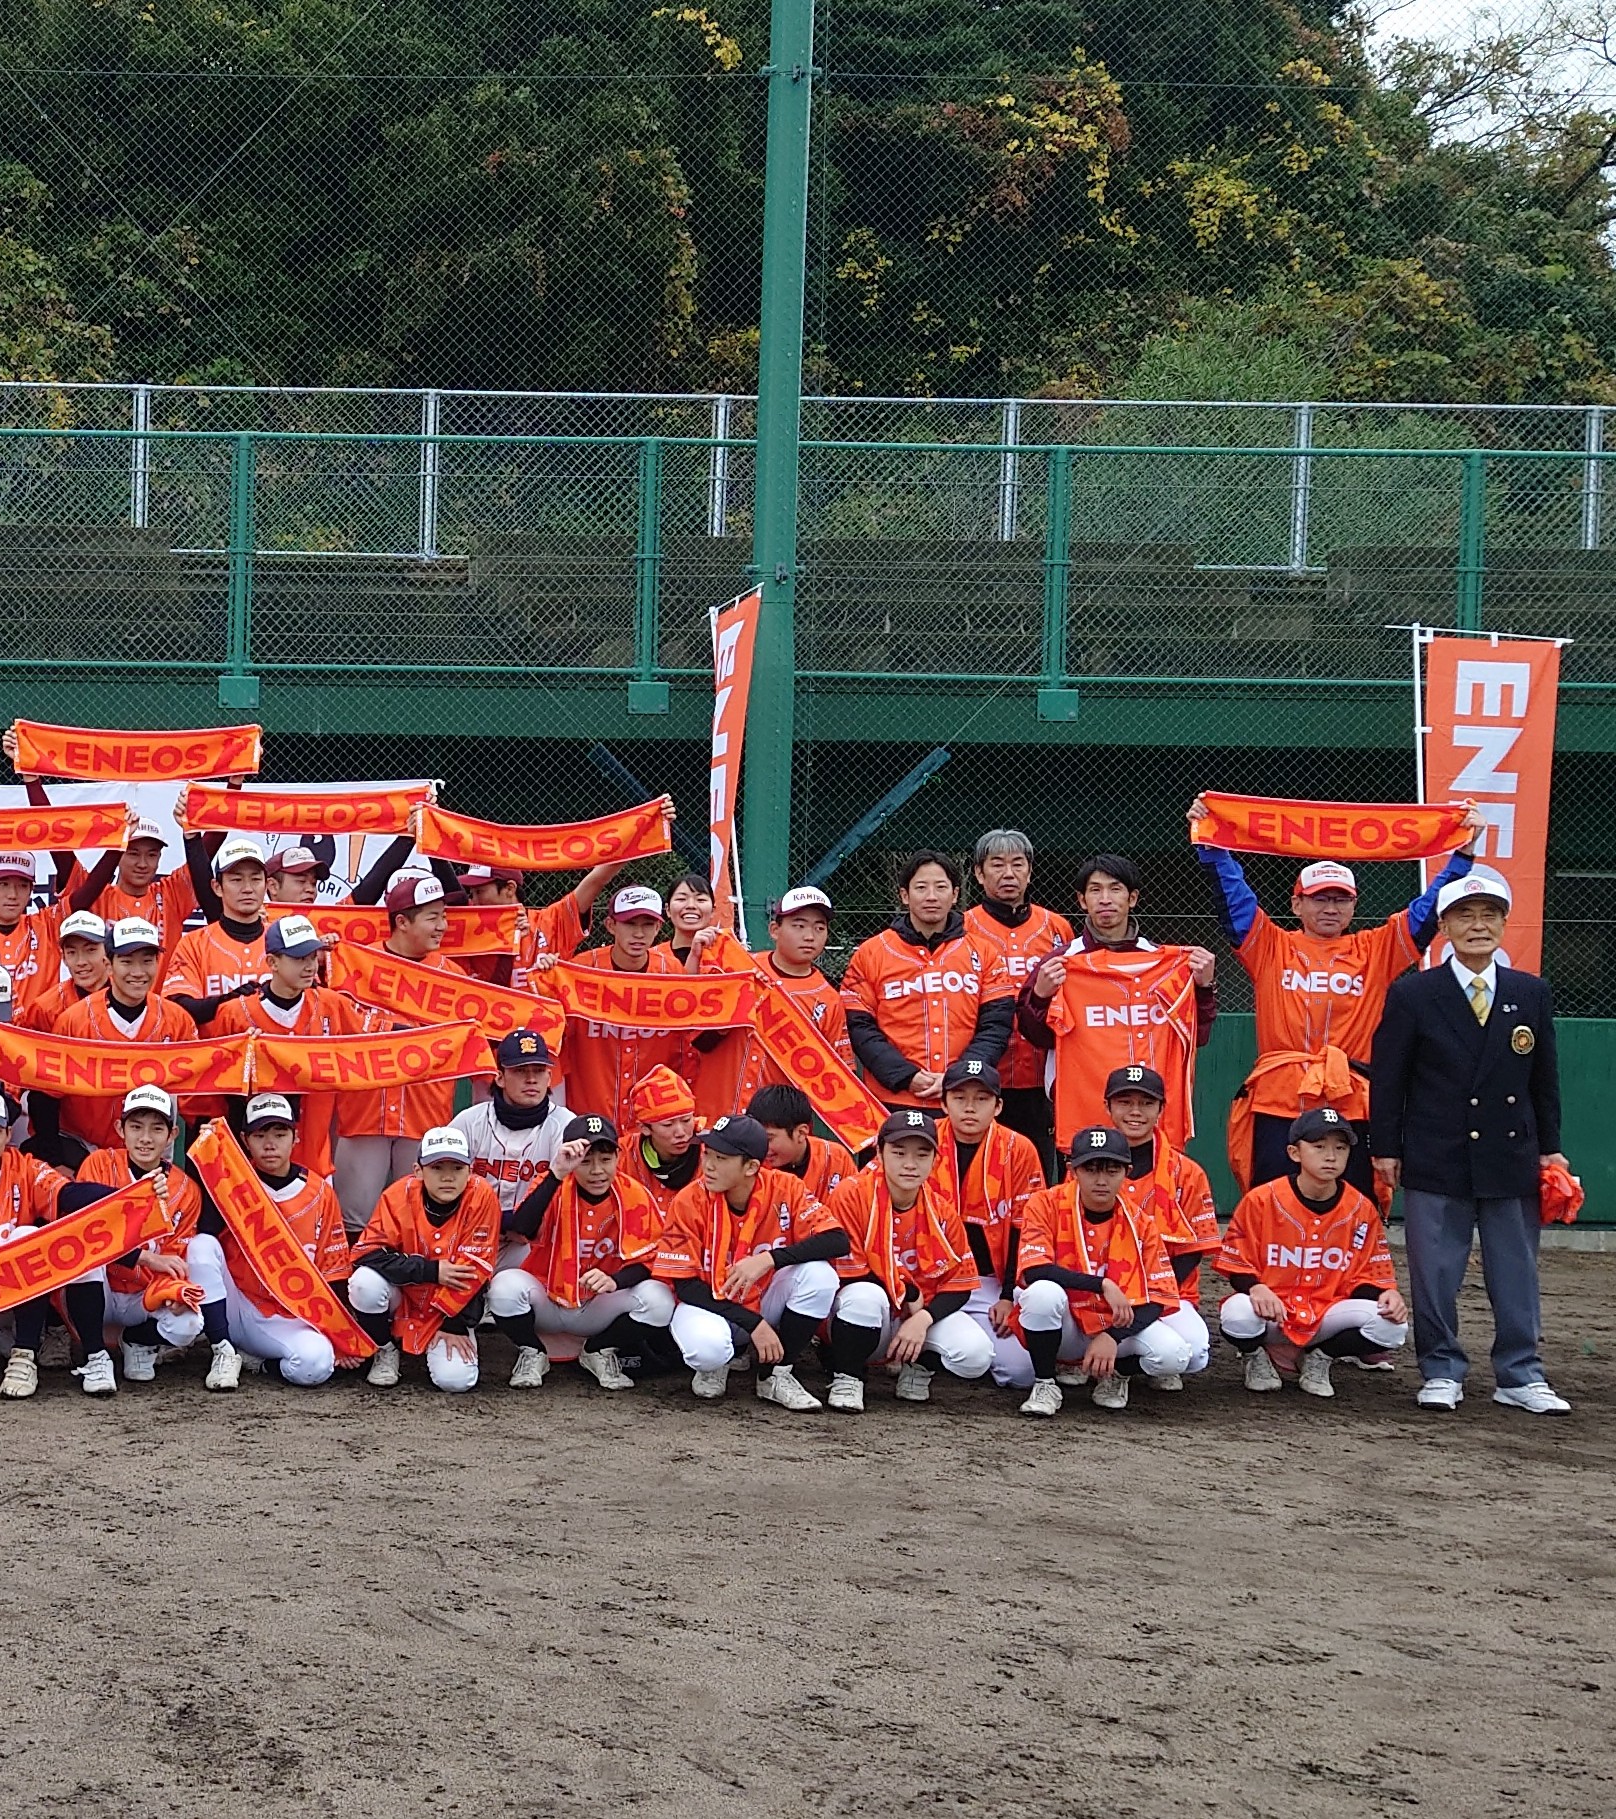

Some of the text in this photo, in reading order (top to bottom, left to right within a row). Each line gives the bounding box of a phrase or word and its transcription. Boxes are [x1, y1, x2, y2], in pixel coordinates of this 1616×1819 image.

[65, 741, 207, 773] ENEOS
[470, 829, 621, 861] ENEOS
[1248, 811, 1419, 850] ENEOS
[318, 880, 341, 897] ORI
[574, 979, 723, 1019] ENEOS
[884, 970, 979, 1000] ENEOS
[1282, 970, 1363, 996] ENEOS
[369, 965, 514, 1037] ENEOS
[1086, 1003, 1168, 1026] ENEO
[308, 1039, 453, 1083] ENEOS
[757, 994, 847, 1102] NEOS
[35, 1048, 193, 1091] ENEOS
[229, 1183, 333, 1323] ENEOS
[1267, 1244, 1354, 1272] ENEOS
